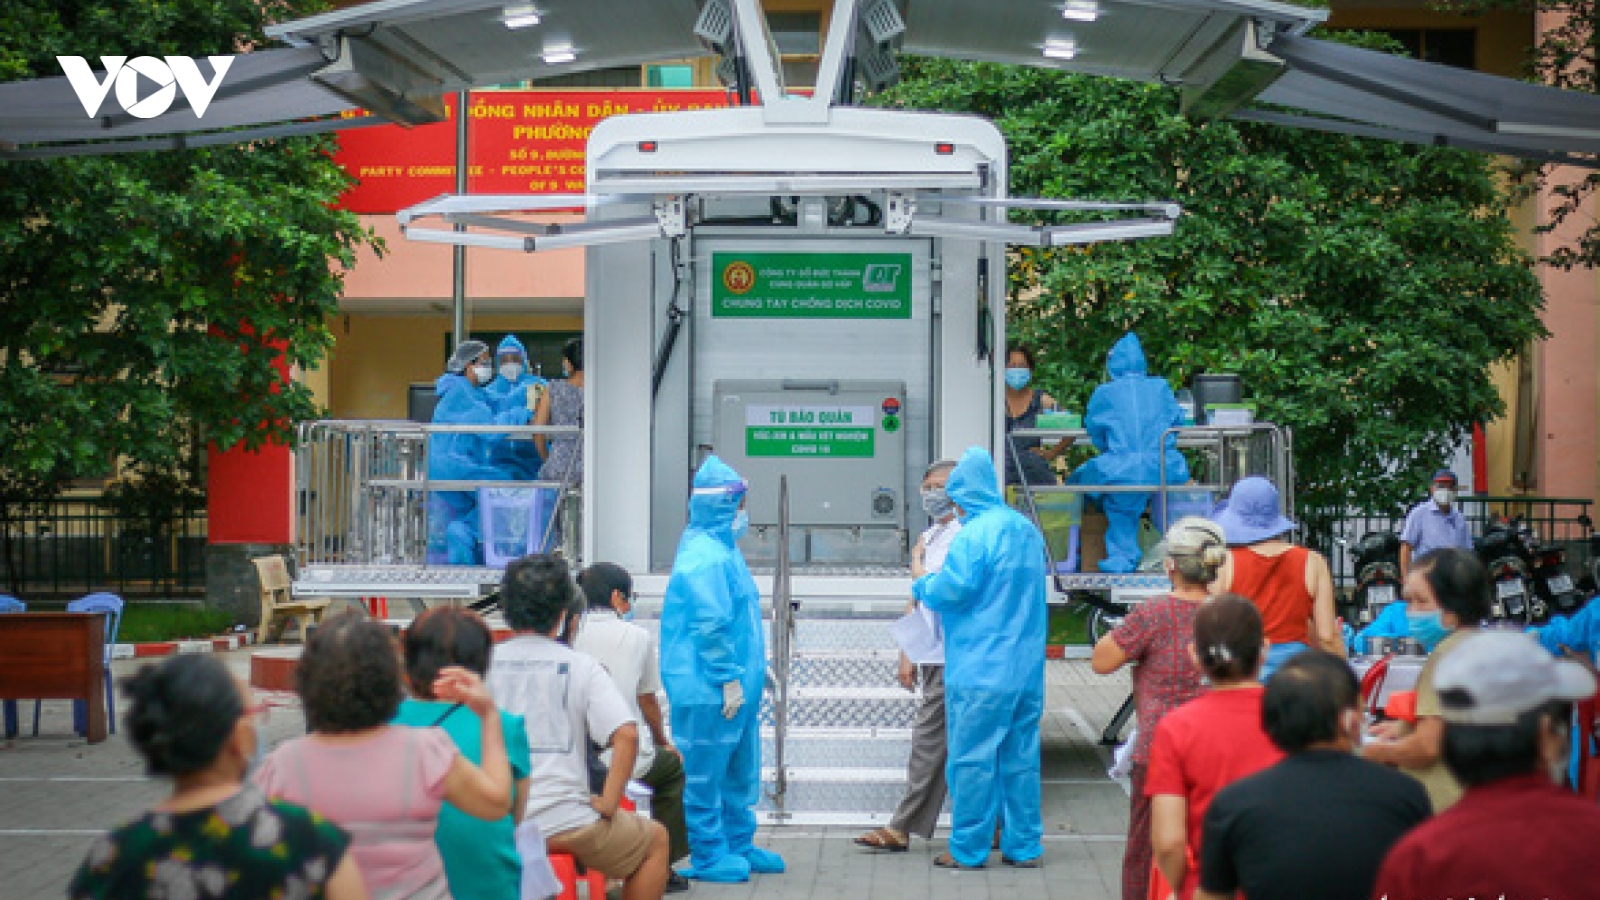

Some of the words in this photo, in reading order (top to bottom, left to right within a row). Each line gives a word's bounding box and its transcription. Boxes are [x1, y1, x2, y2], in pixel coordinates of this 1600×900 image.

[524, 101, 579, 119] NHÂN
[360, 166, 404, 178] PARTY
[722, 298, 762, 309] CHUNG
[767, 298, 788, 309] TAY
[865, 298, 901, 309] COVID
